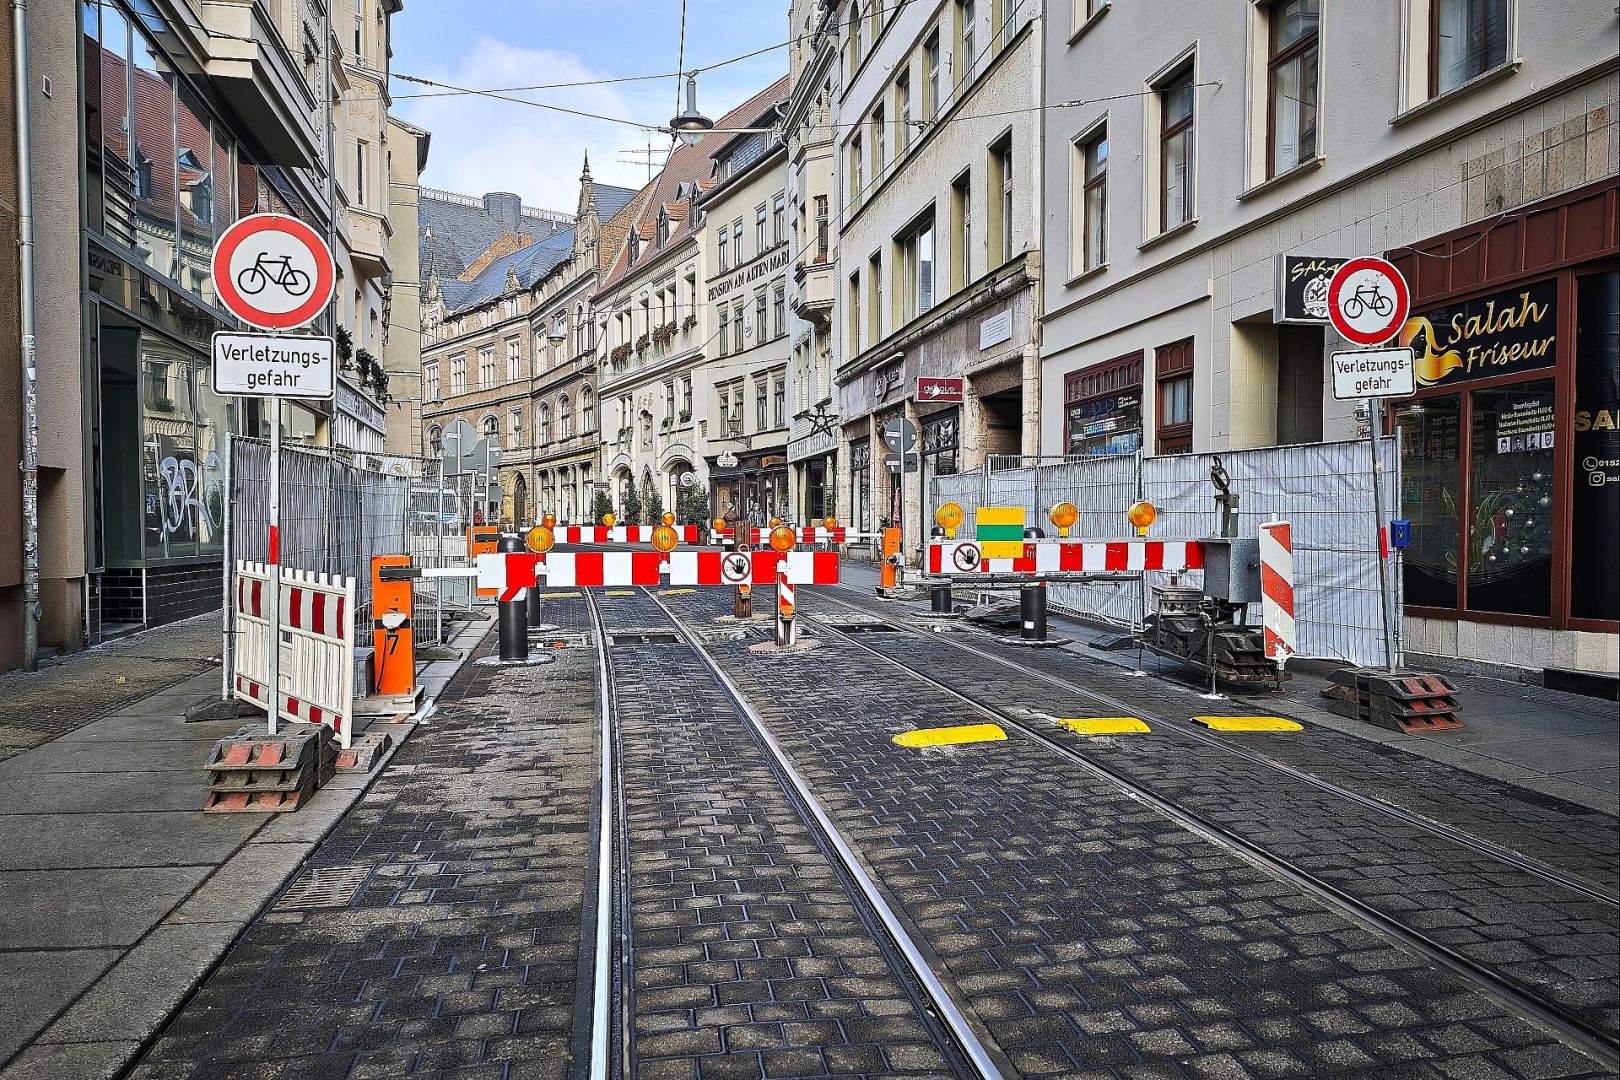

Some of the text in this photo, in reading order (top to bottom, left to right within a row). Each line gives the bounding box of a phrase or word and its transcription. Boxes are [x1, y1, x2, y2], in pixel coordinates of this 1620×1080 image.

[708, 277, 733, 302] PENSION
[734, 271, 745, 289] AM
[746, 260, 769, 283] ALTEN
[1448, 291, 1549, 345] Salah
[221, 343, 329, 368] Verletzungs-
[1466, 336, 1555, 373] Friseur
[1336, 359, 1410, 374] Verletzungs-
[247, 370, 301, 389] gefahr
[1355, 376, 1392, 394] gefahr
[387, 634, 399, 656] 7
